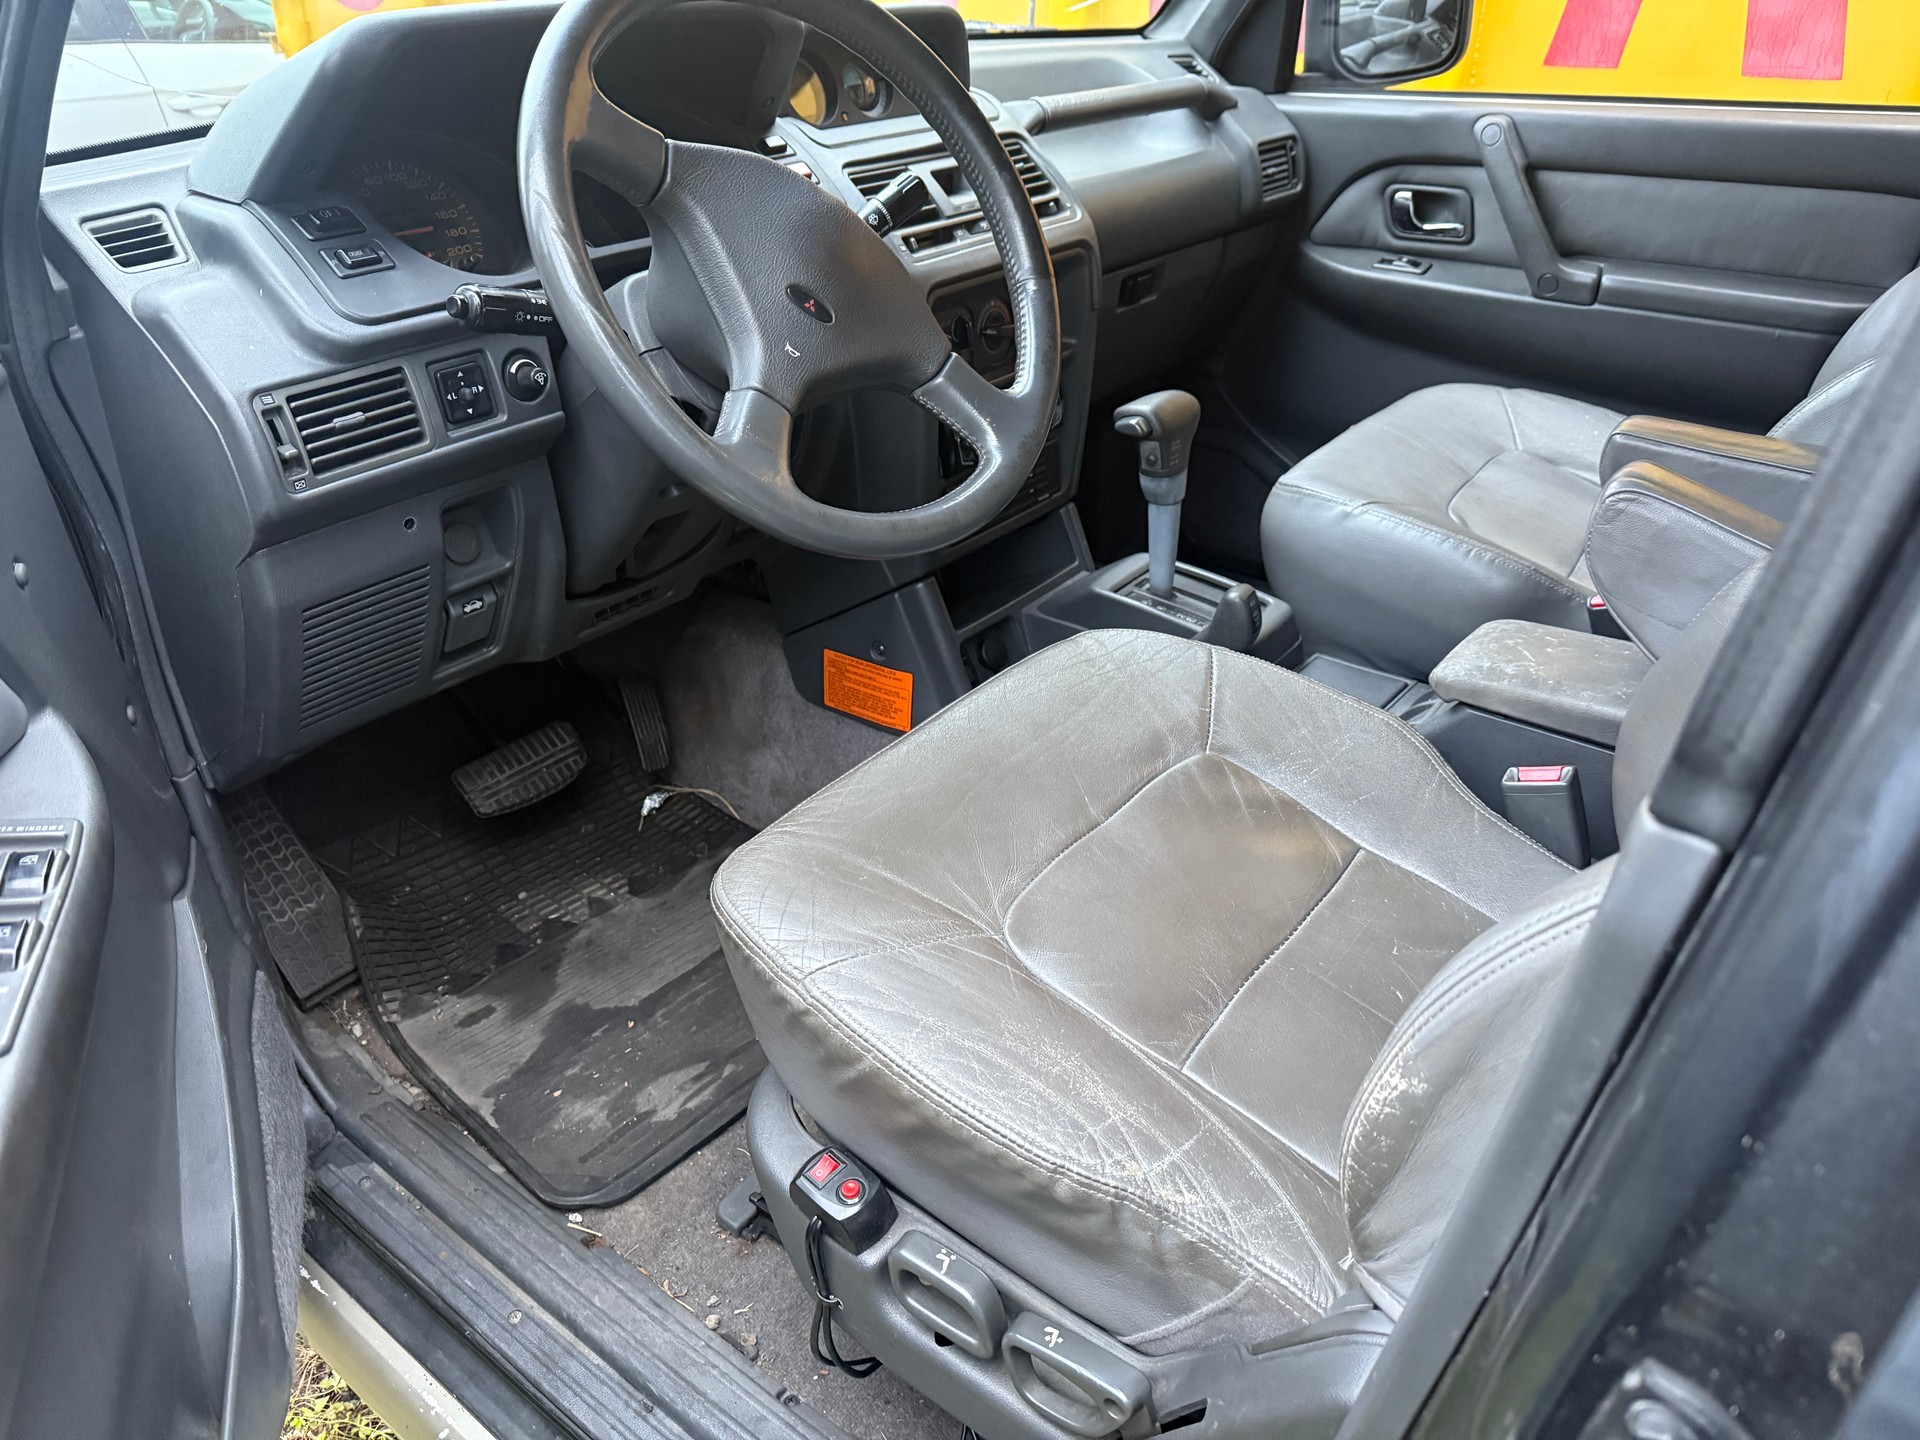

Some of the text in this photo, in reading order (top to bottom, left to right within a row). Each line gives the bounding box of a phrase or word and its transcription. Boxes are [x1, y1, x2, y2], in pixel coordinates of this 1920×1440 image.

[425, 191, 447, 201] 140
[434, 209, 458, 220] 160
[445, 226, 468, 238] 180
[446, 244, 472, 257] 200
[538, 315, 553, 323] OFF
[471, 386, 478, 394] R
[452, 392, 458, 400] L
[16, 824, 64, 832] WINDOWS
